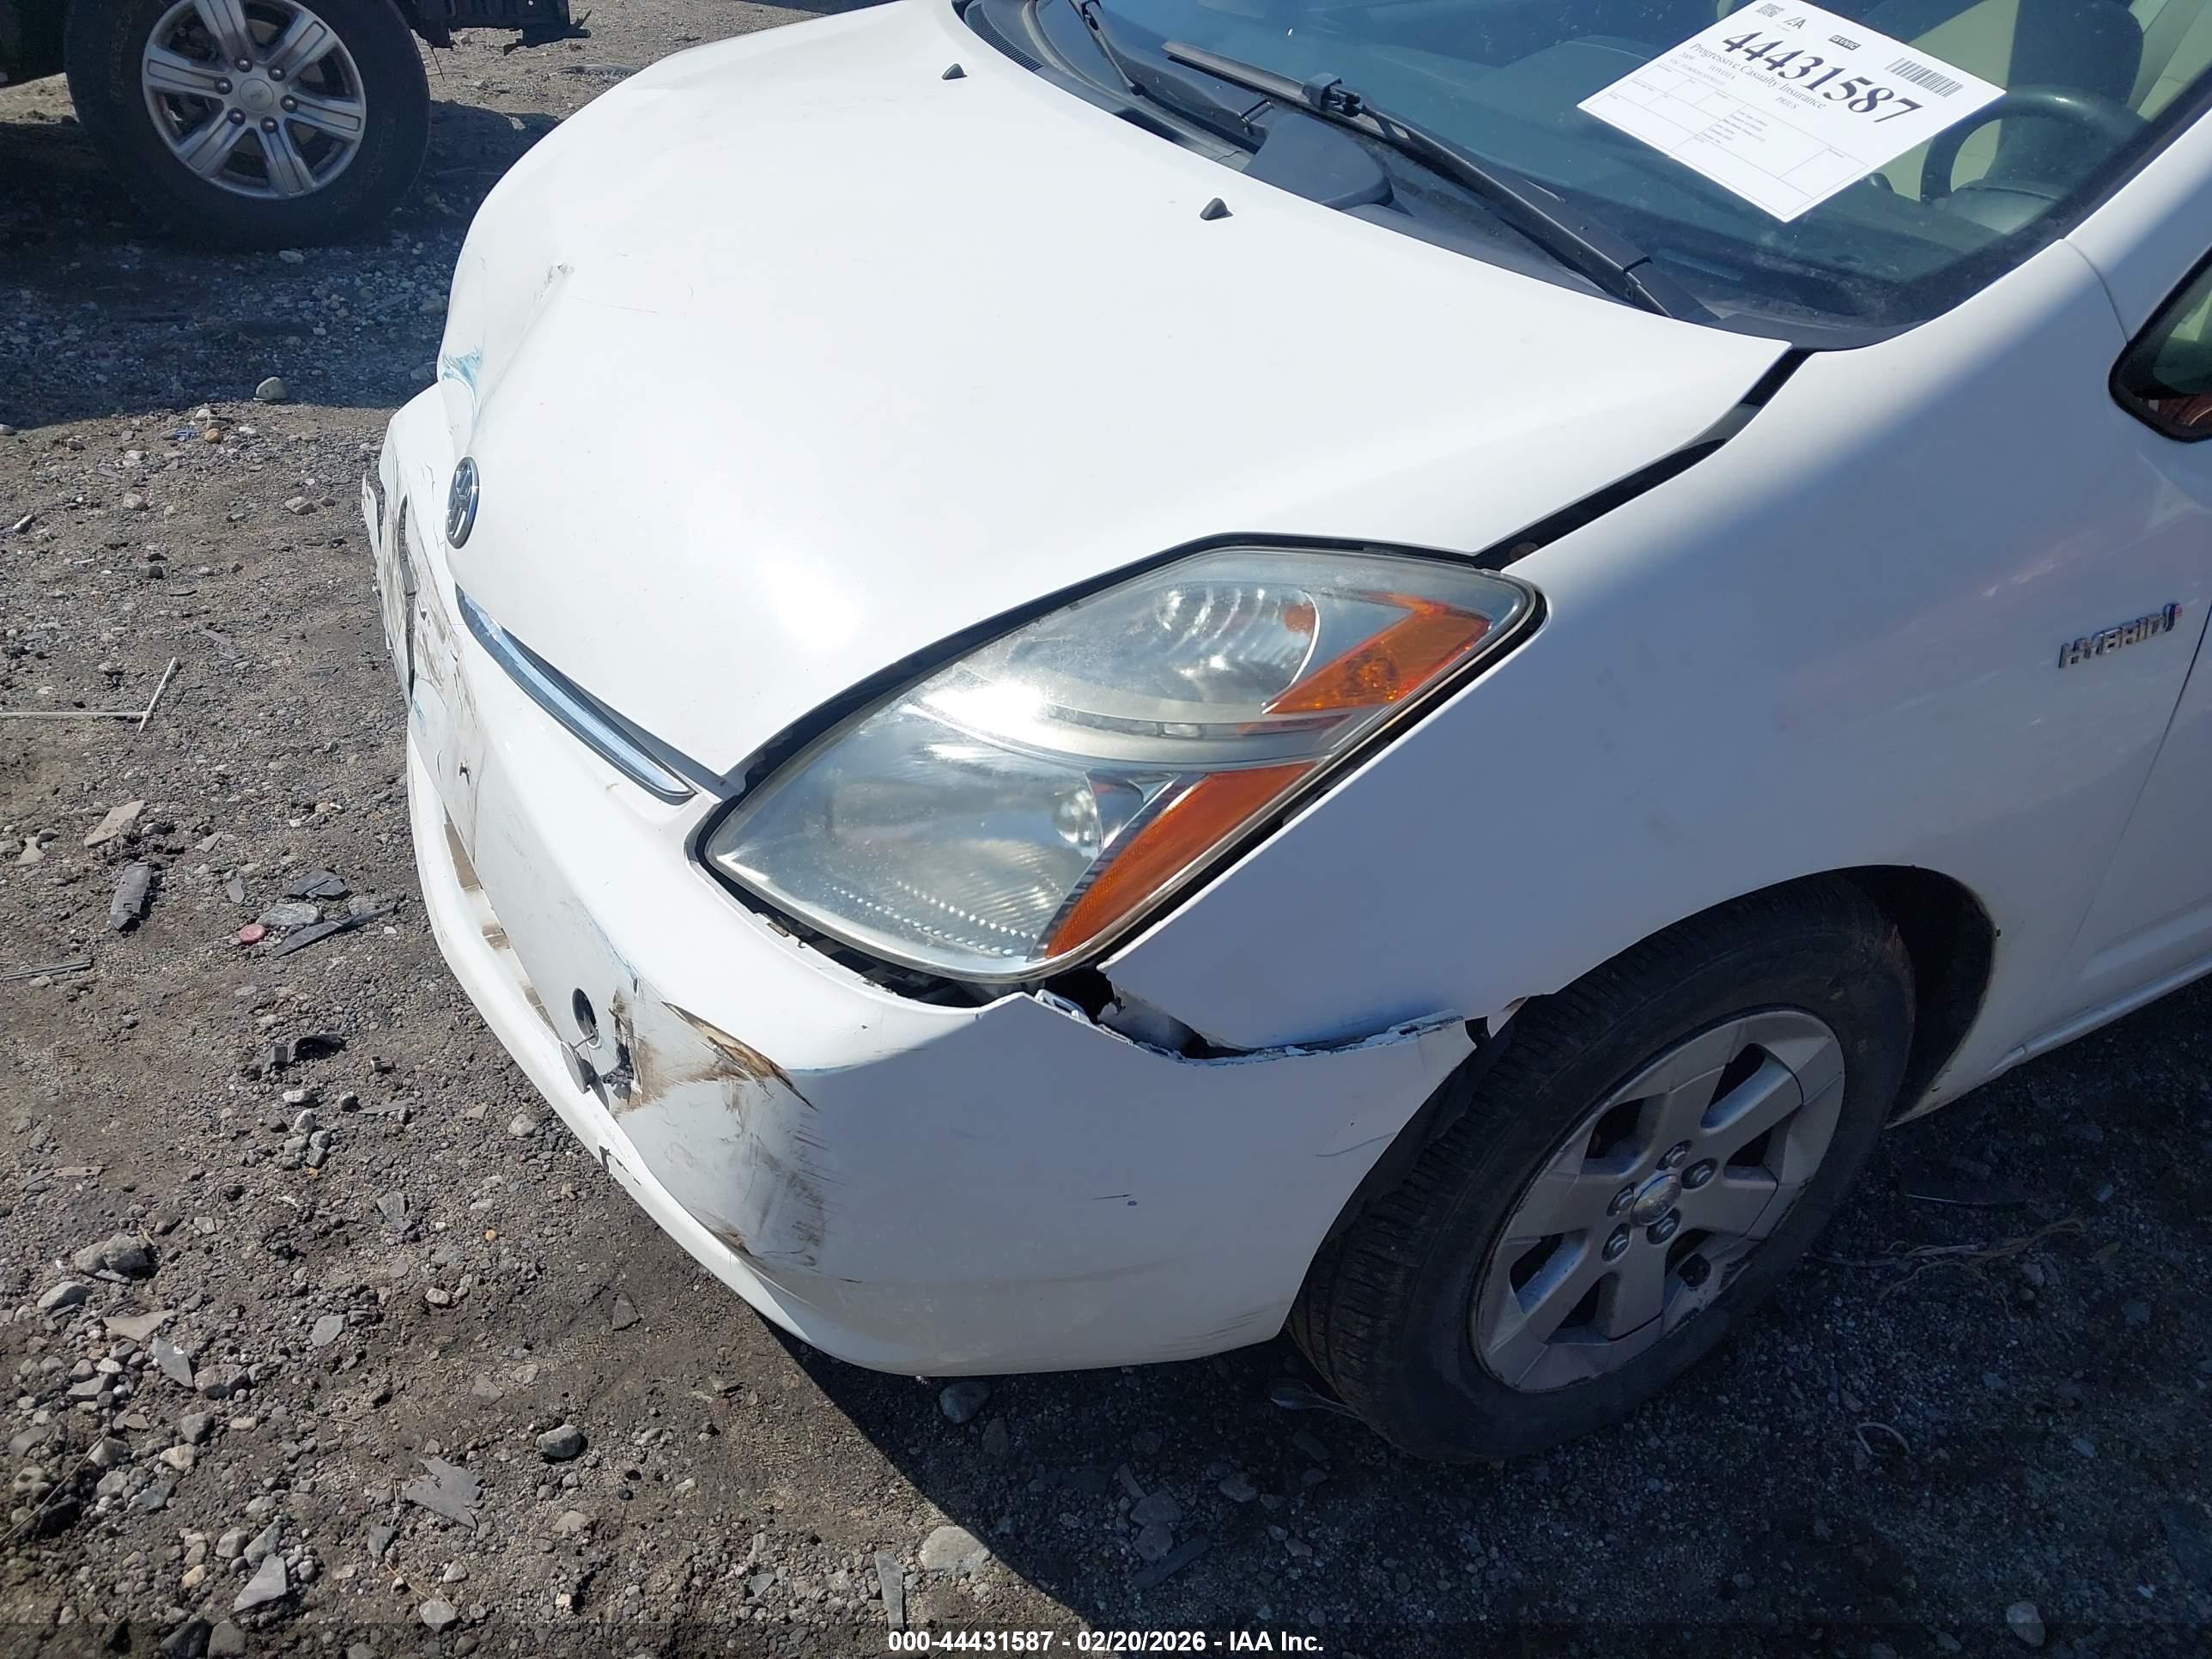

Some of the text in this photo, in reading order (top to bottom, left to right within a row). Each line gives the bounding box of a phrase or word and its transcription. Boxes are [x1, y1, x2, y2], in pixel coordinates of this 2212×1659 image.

[1689, 42, 1741, 70] Progressive
[1740, 64, 1778, 88] Casualty
[1779, 82, 1826, 110] Insurance
[1723, 32, 1923, 123] 44431587
[1774, 96, 1799, 109] PRIUS
[2058, 603, 2182, 668] HYBRID
